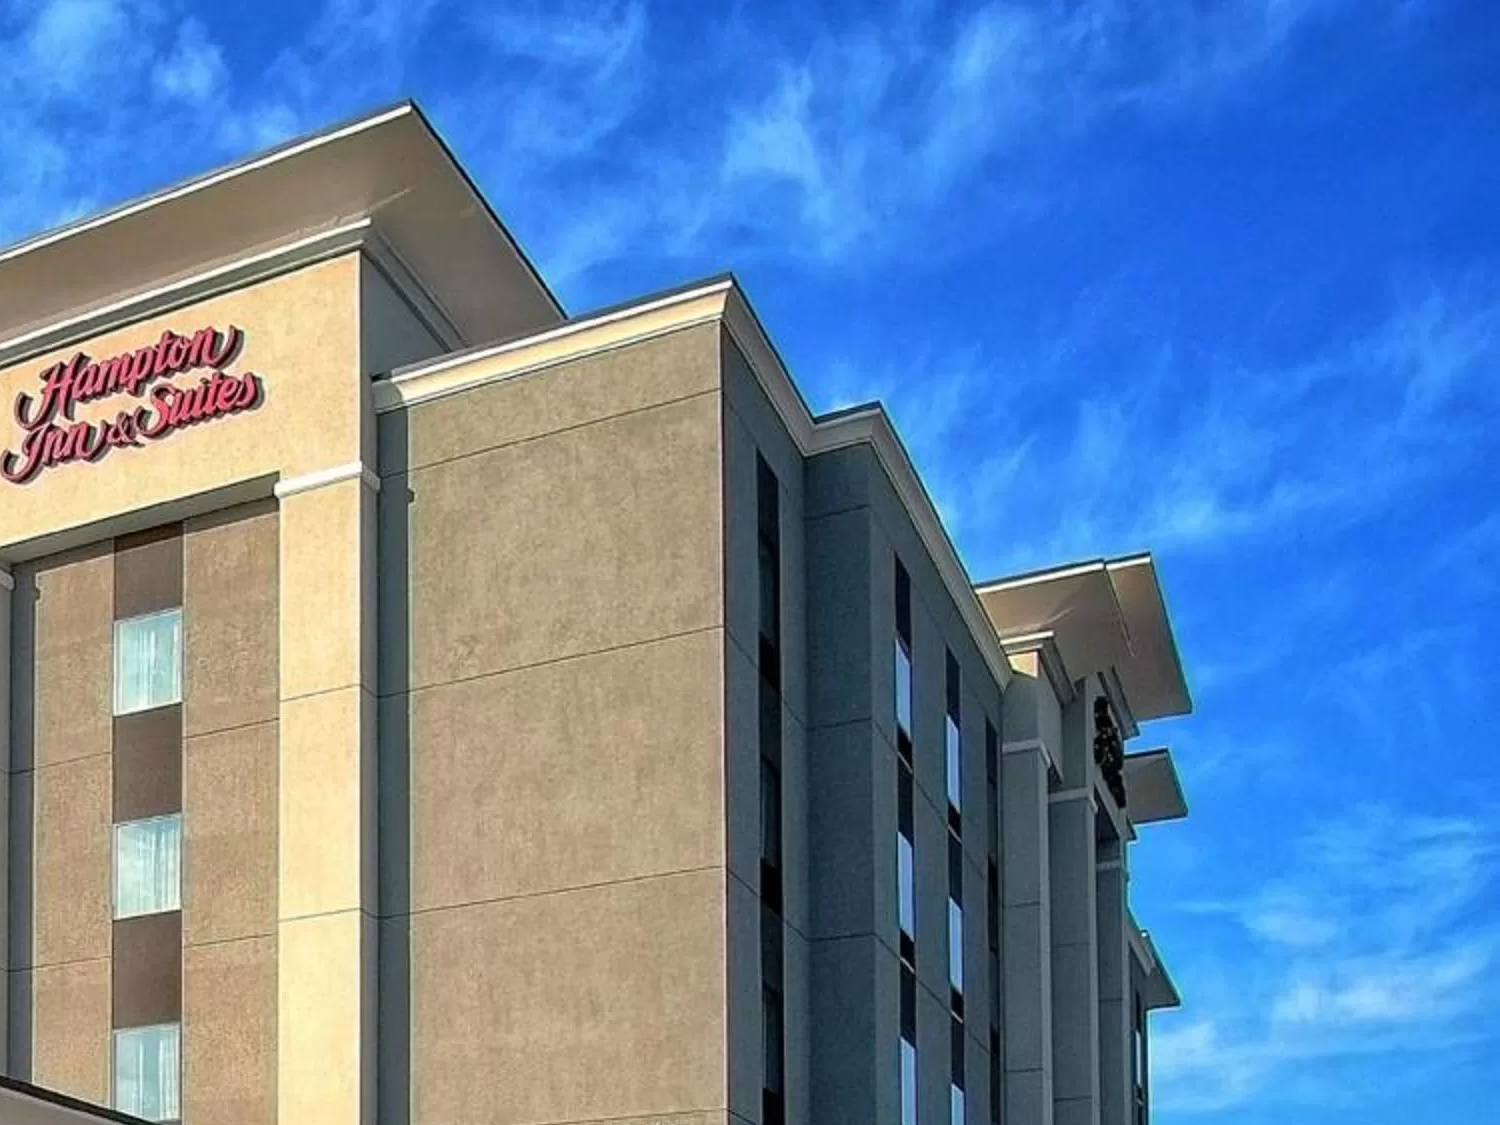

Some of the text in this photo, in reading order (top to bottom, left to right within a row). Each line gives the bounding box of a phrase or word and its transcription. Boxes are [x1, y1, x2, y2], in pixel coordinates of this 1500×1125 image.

[1, 419, 112, 484] Inn
[136, 371, 265, 440] Suites
[15, 325, 244, 430] Hampton
